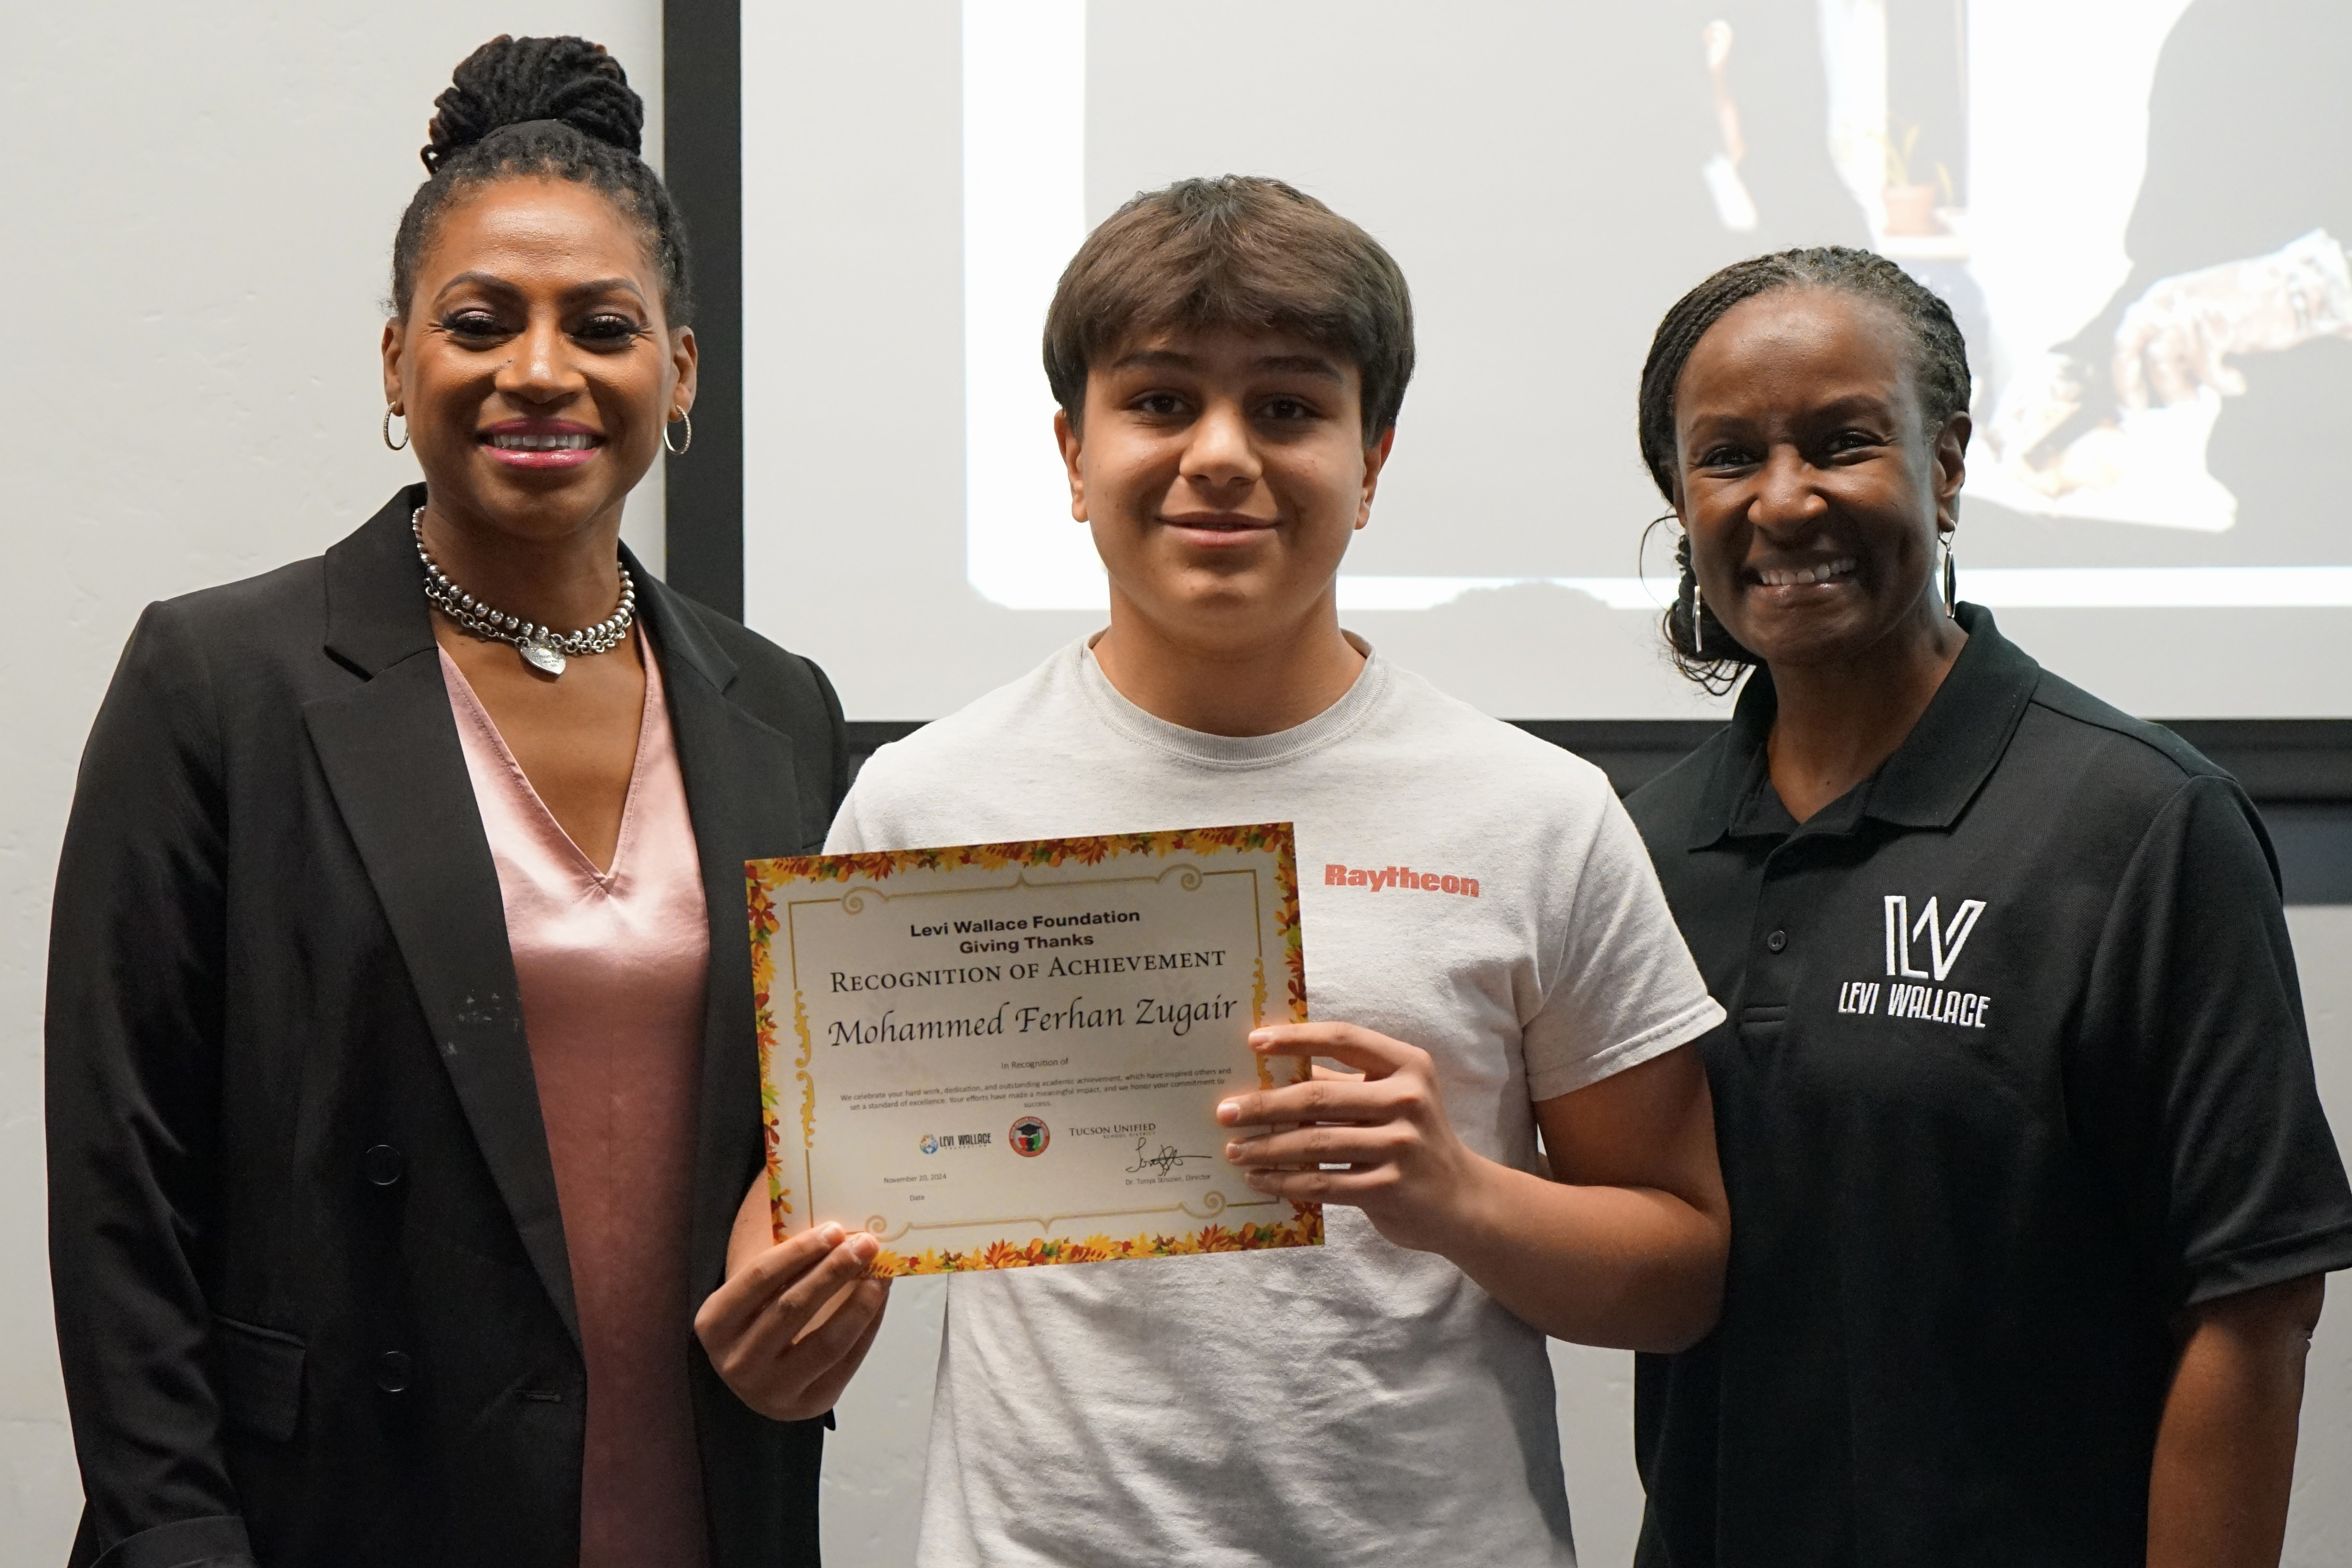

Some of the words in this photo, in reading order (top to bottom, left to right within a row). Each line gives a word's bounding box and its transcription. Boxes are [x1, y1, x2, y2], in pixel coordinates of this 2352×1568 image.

[1324, 864, 1480, 898] Raytheon
[910, 922, 948, 937] Levi
[954, 918, 1028, 933] Wallace
[1032, 911, 1140, 929] Foundation
[960, 940, 1019, 954] Giving
[1024, 933, 1094, 949] Thanks
[1838, 982, 1880, 1015] LEVI
[1888, 984, 1991, 1028] WALLACE
[828, 1002, 1011, 1046] Mohammed
[1016, 996, 1124, 1033] Ferhan
[1136, 994, 1238, 1036] Zugair
[1012, 1060, 1058, 1069] Recognition
[868, 1100, 898, 1109] standard
[1036, 1088, 1074, 1097] meaningful
[1170, 1079, 1215, 1087] commitment
[944, 1085, 983, 1094] dedication,
[999, 1081, 1040, 1089] outstanding
[1077, 1075, 1123, 1084] achievement,
[1165, 1069, 1192, 1078] inspired
[940, 1136, 954, 1147] LEVI
[958, 1133, 991, 1145] WALLACE
